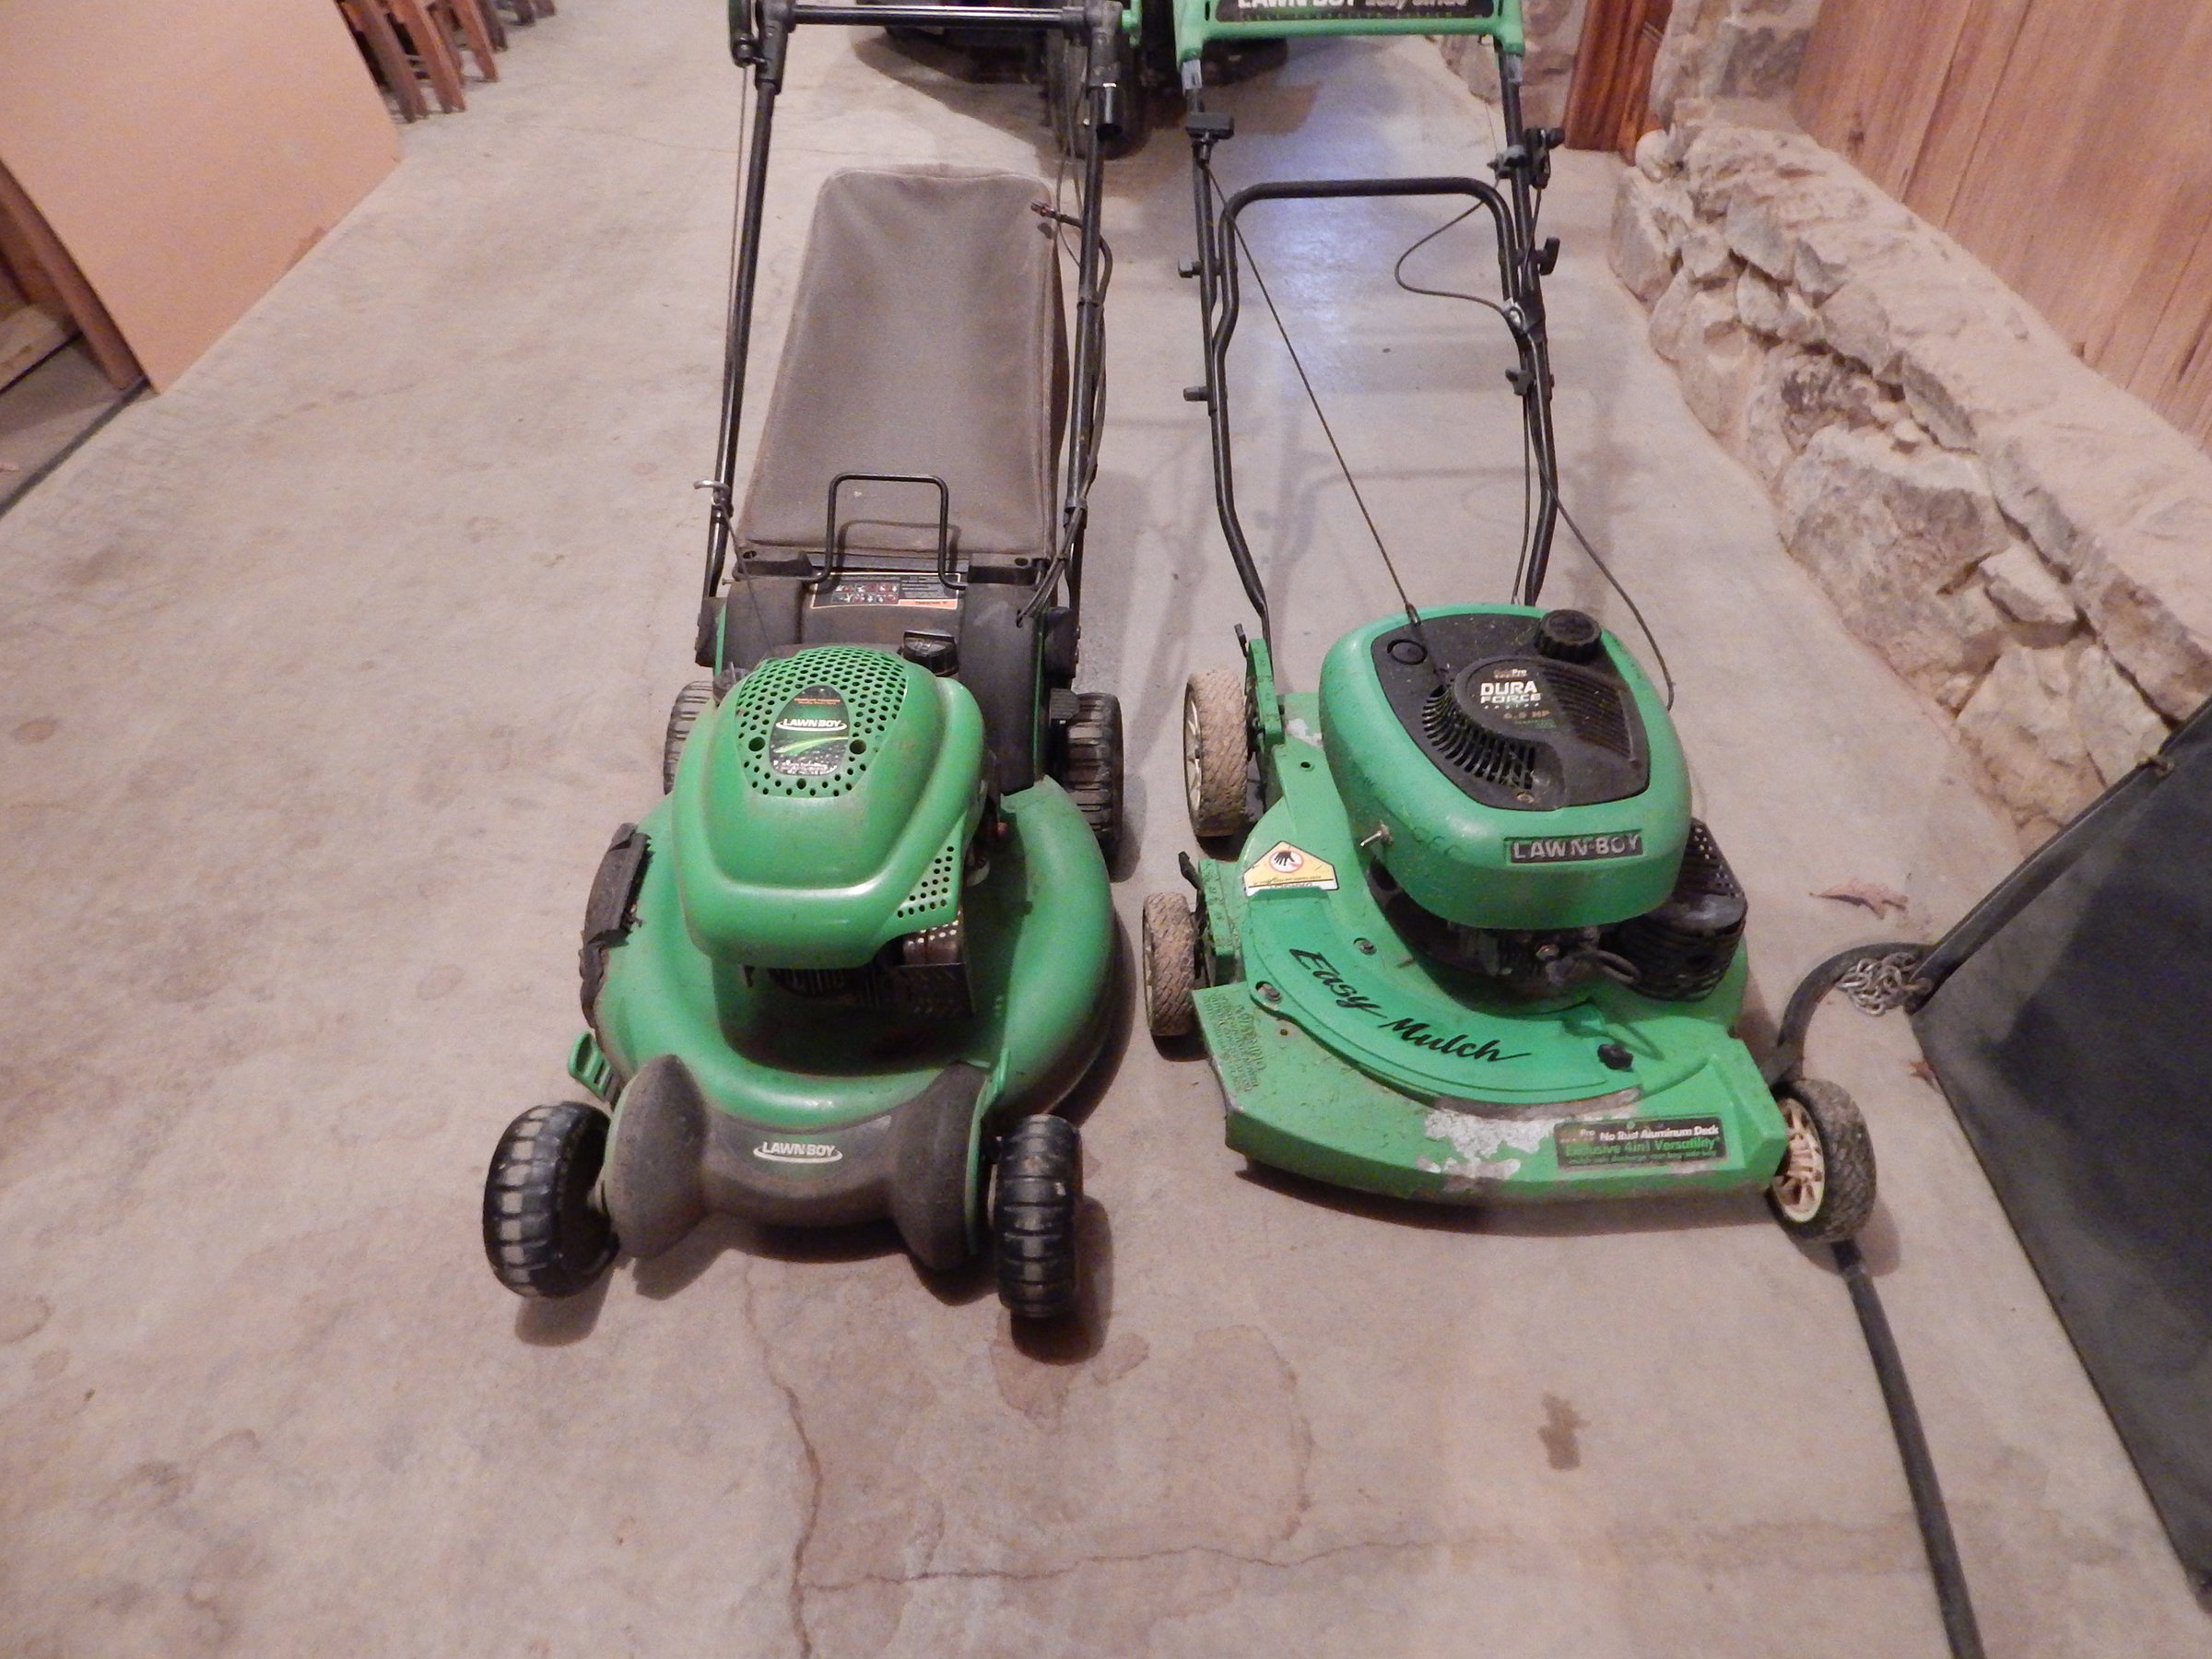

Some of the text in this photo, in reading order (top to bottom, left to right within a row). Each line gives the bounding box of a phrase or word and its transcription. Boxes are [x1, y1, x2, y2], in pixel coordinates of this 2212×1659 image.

[1480, 680, 1538, 696] DURA
[1480, 692, 1542, 704] FORCE
[1288, 947, 1532, 1063] Easy Mulch
[1599, 1124, 1719, 1141] No Rust Aluminum Deck
